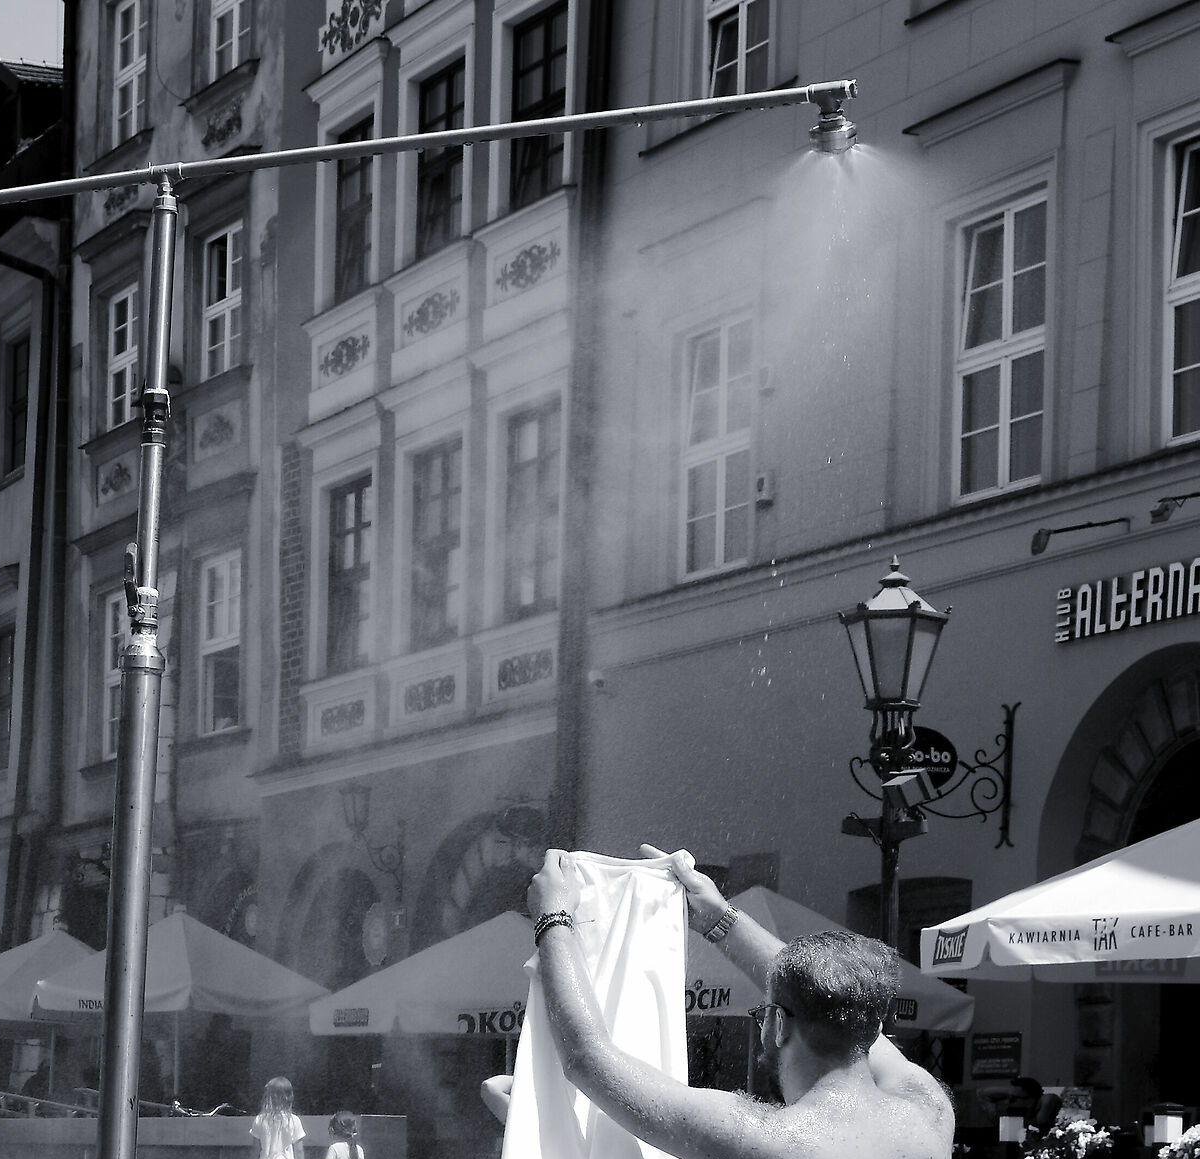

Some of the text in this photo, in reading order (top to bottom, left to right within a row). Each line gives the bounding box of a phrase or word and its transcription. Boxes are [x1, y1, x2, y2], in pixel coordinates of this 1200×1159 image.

[1054, 587, 1072, 643] KLUB
[914, 746, 952, 764] o-bo
[935, 932, 966, 960] TYSKIE
[1008, 917, 1193, 951] KAWIARNIA TAK CAFE-BAR
[78, 999, 104, 1010] INDIA
